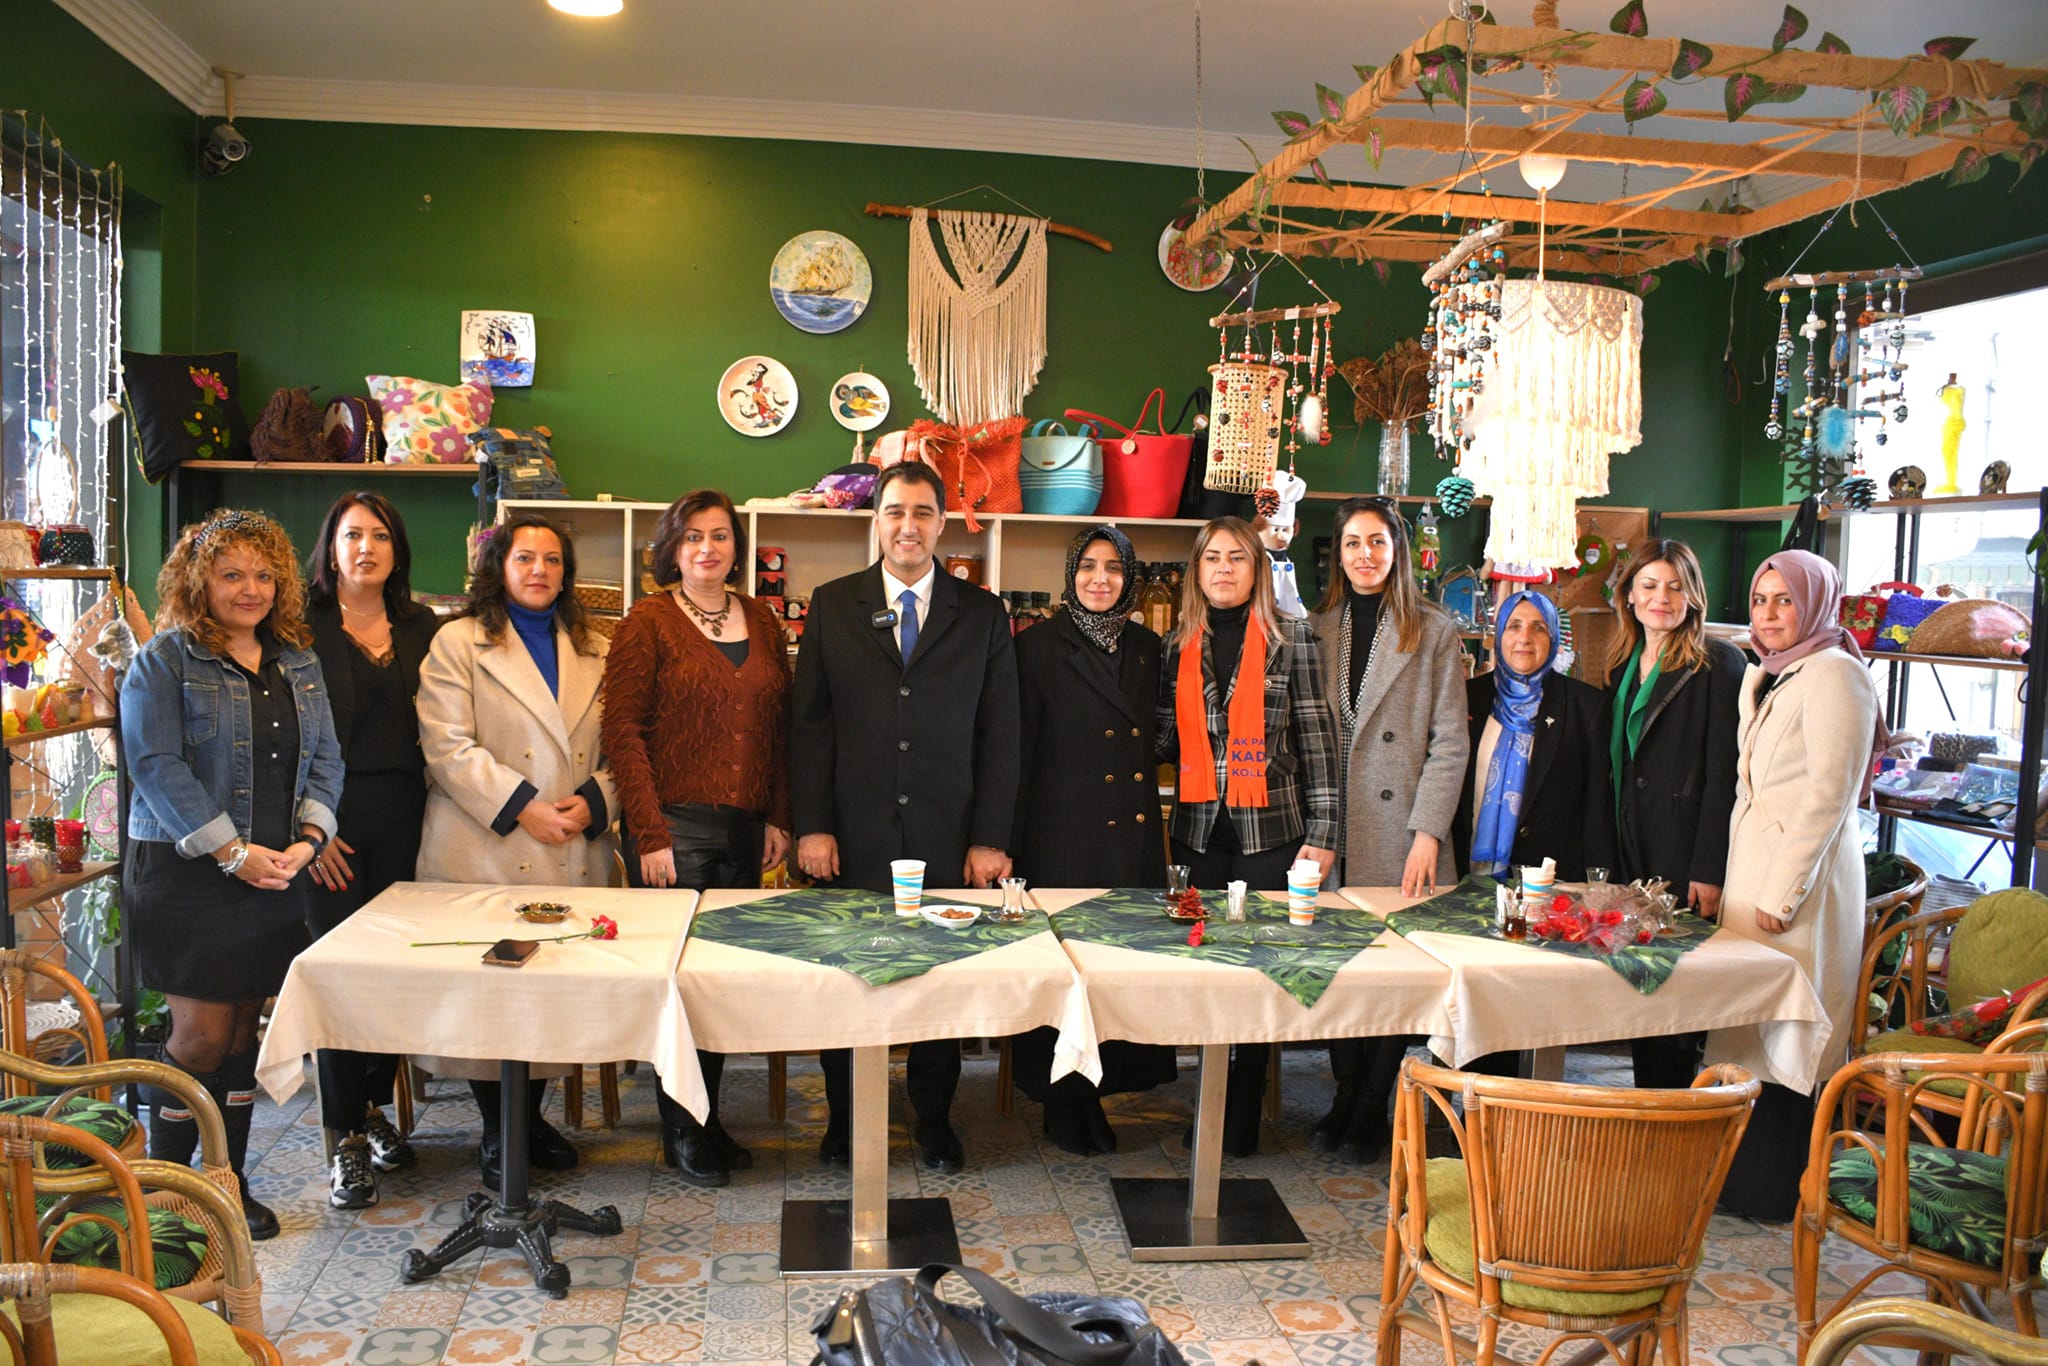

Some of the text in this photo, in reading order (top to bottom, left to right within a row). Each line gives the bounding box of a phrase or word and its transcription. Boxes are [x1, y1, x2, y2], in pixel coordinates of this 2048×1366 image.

[1232, 738, 1265, 746] AK PA
[1231, 751, 1266, 762] KAD
